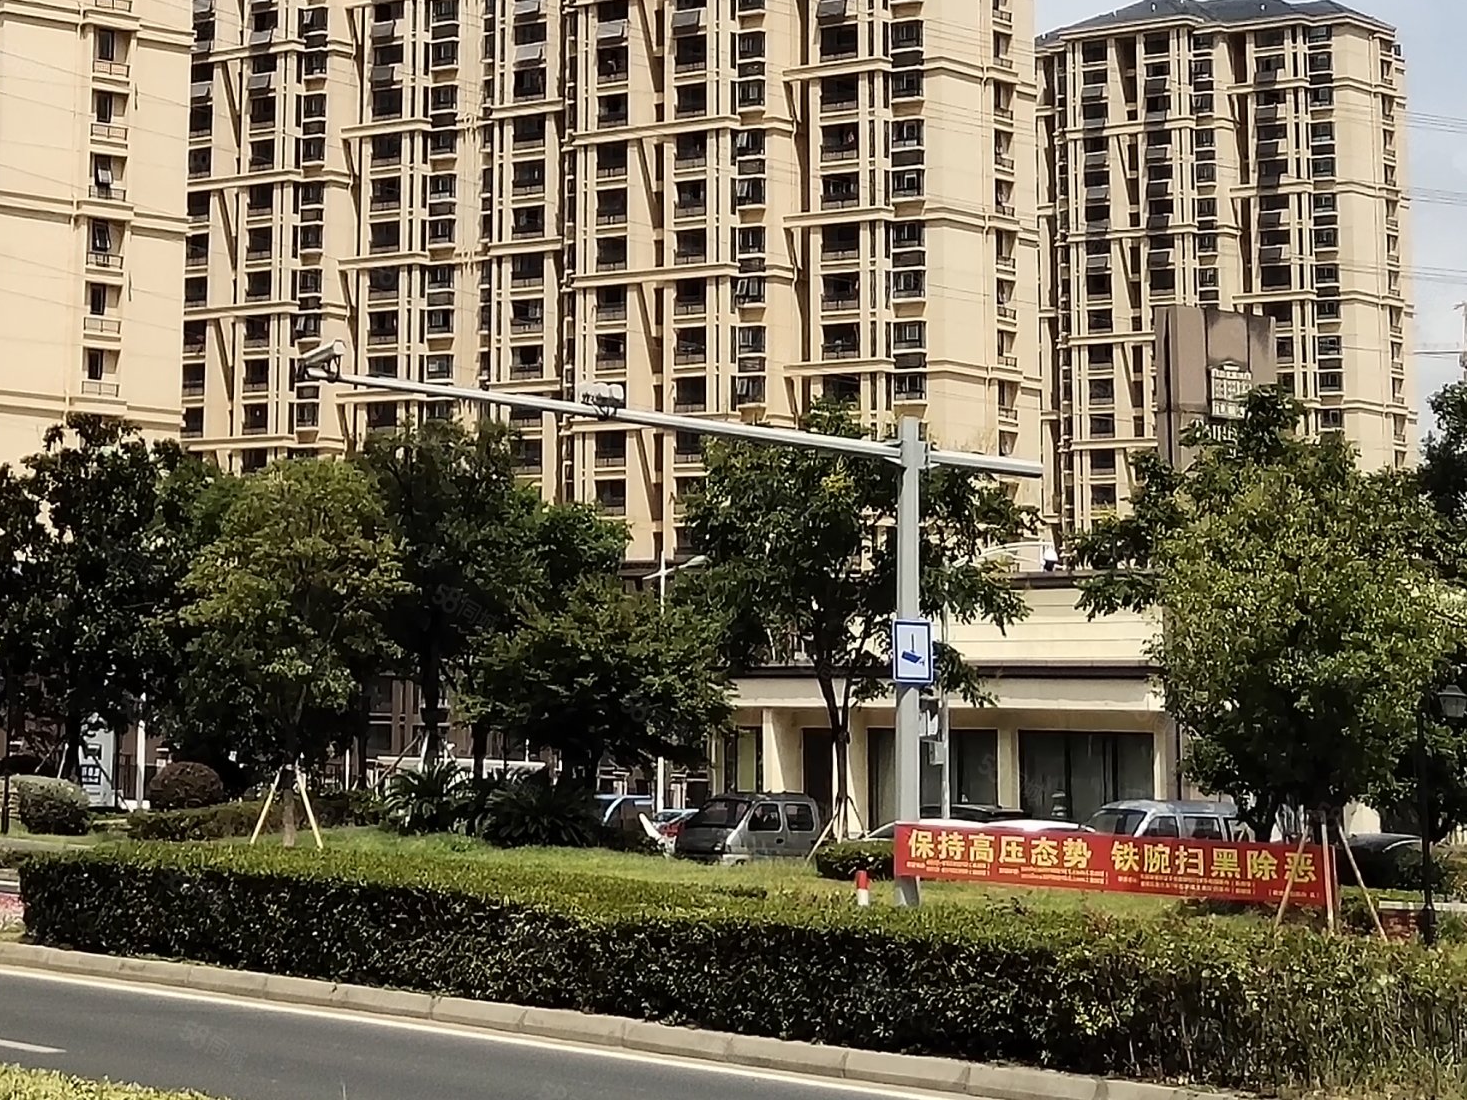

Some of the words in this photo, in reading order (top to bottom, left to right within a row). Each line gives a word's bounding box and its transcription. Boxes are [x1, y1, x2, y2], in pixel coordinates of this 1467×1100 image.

[908, 828, 1092, 868] 保持高压态势
[1110, 840, 1317, 883] 铁腕扫黑除恶
